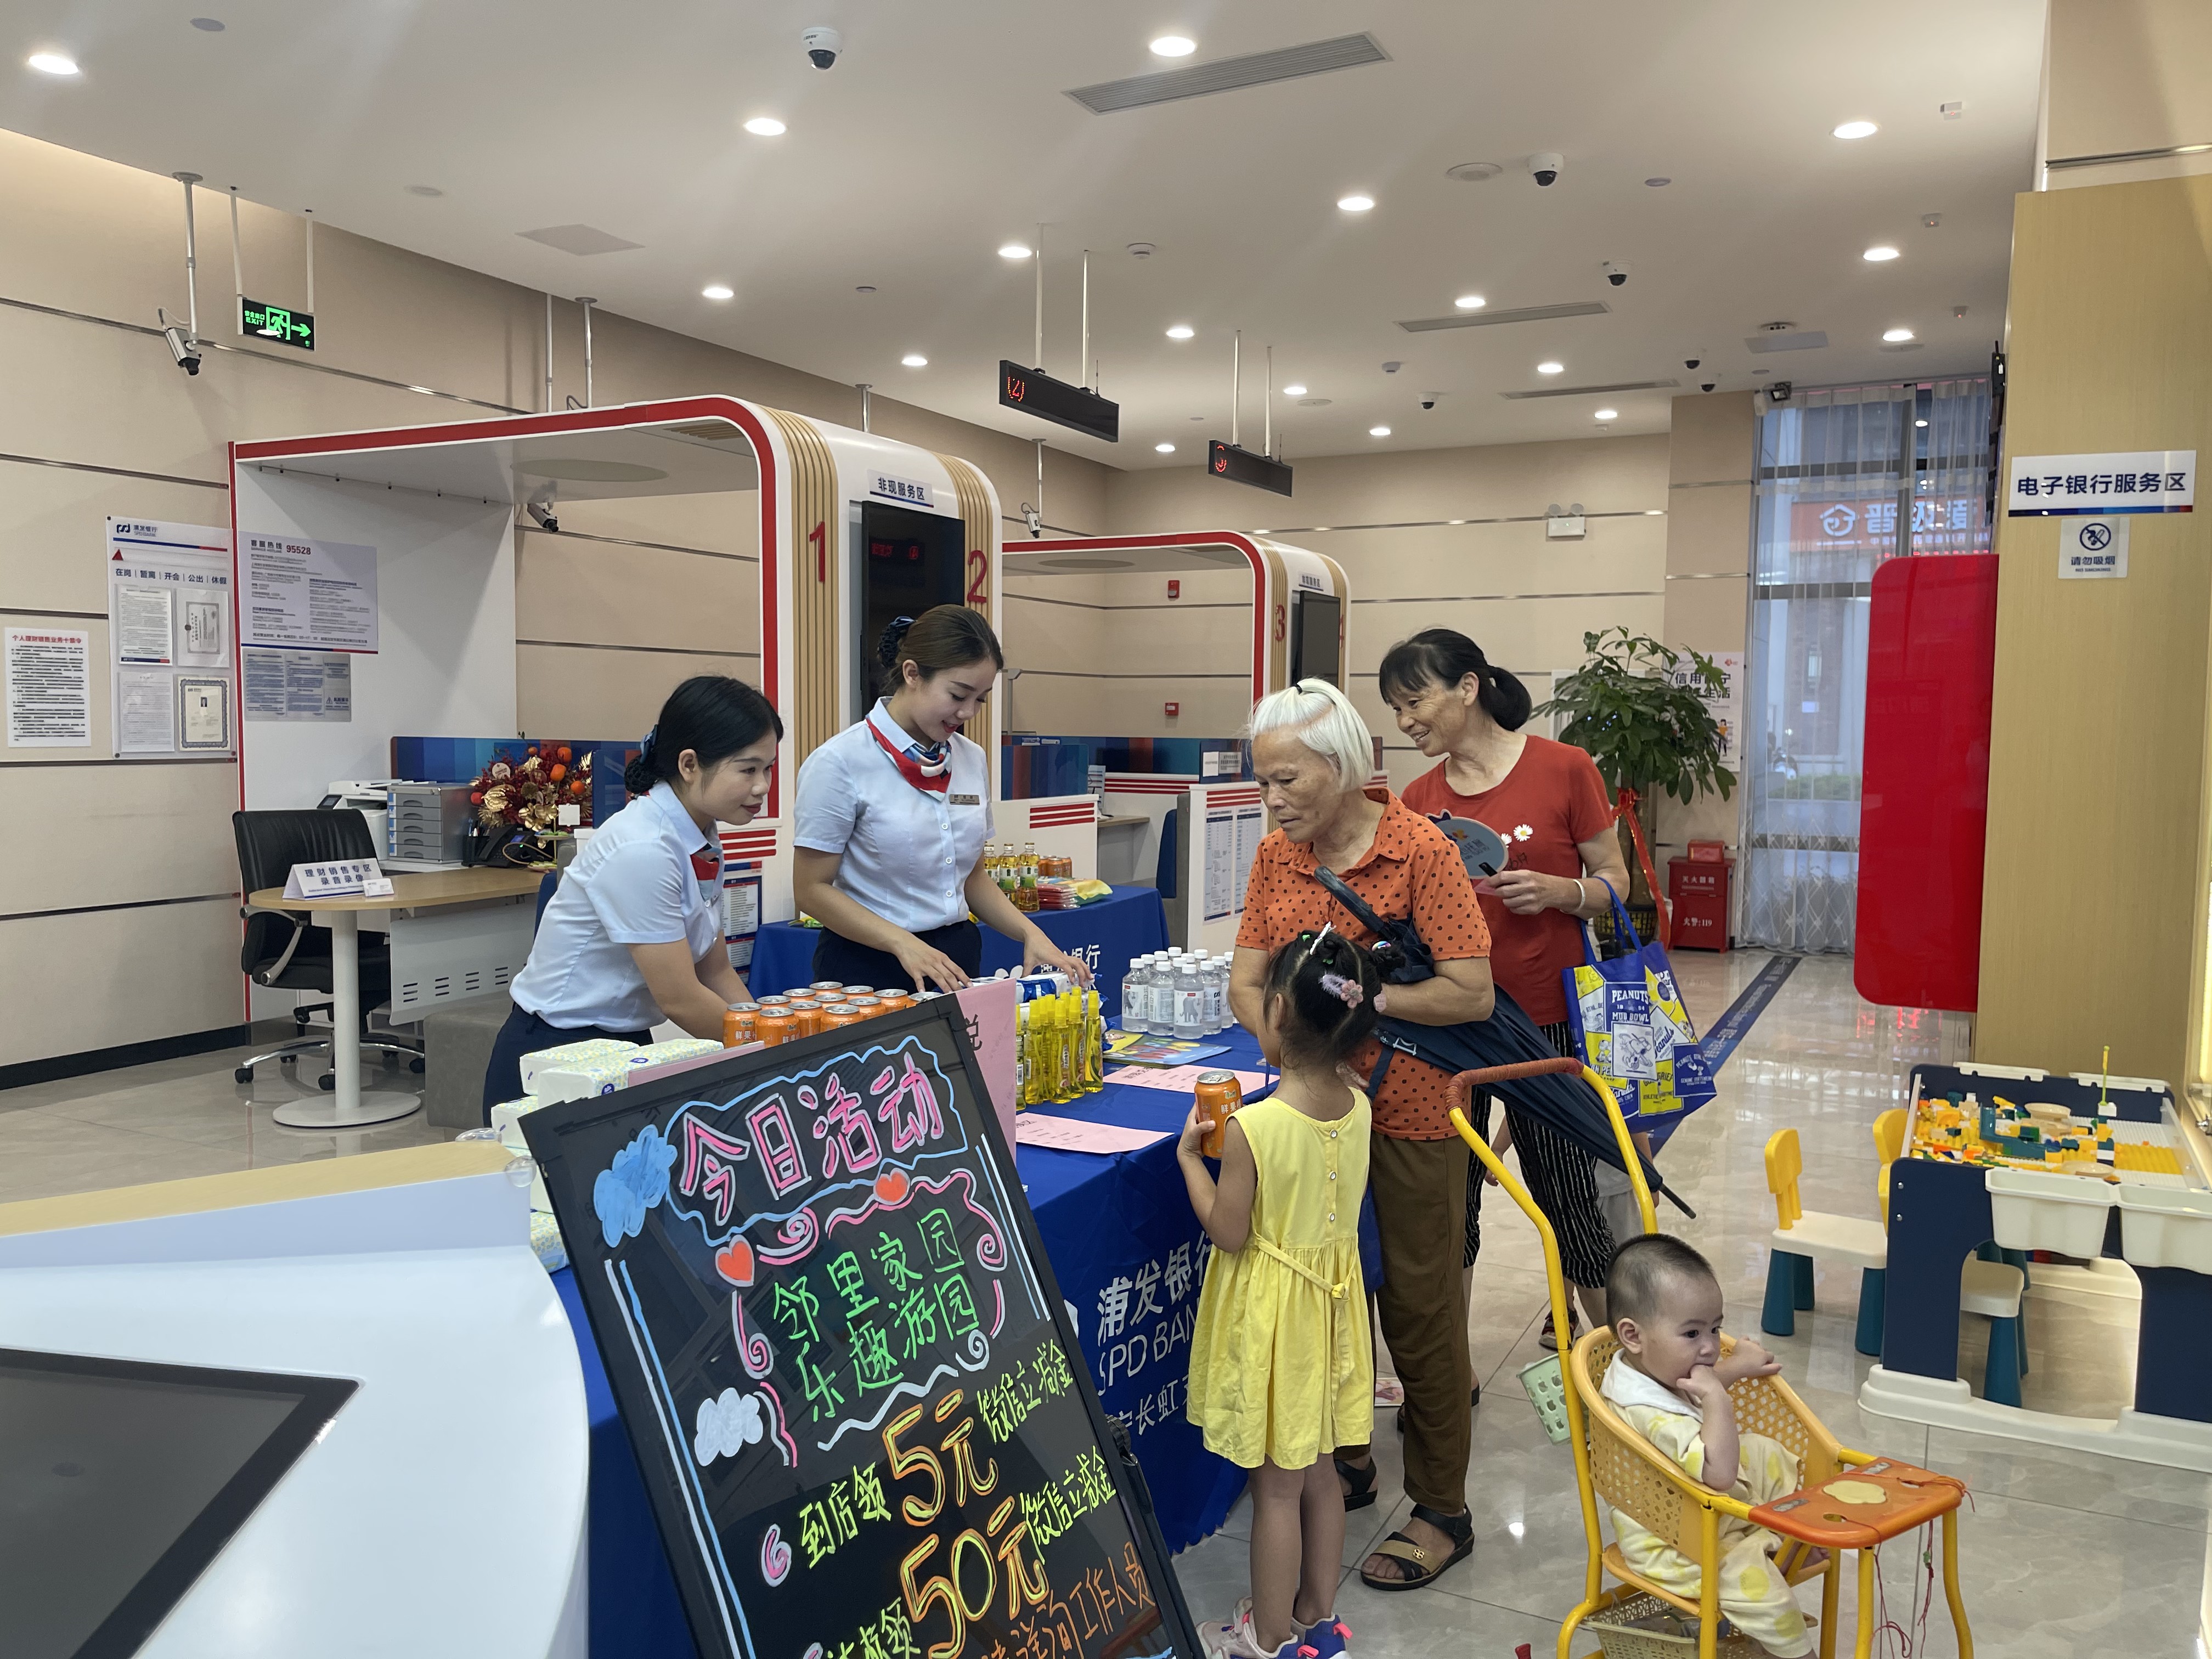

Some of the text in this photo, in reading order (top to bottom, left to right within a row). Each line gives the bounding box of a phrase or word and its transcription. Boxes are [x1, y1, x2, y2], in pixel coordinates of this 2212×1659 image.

[246, 317, 264, 325] EXIT
[878, 477, 925, 500] 非现服务区
[2017, 472, 2186, 495] 电子银行服务区
[286, 544, 311, 555] 95528
[809, 521, 825, 583] 1
[2071, 555, 2115, 566] 请勿吸烟
[116, 568, 131, 577] 在岗
[165, 572, 180, 581] 开会
[188, 574, 204, 583] 公出
[212, 576, 227, 584] 休假
[967, 550, 987, 603] 2
[1274, 604, 1285, 642] 3
[305, 864, 371, 877] 理财销售专区
[1682, 876, 1715, 884] 灭火器箱
[1612, 990, 1649, 1005] PEANUTS
[680, 1052, 943, 1226] 今日活动
[774, 1208, 964, 1342] 邻里家园
[797, 1273, 979, 1422] 乐趣游园
[1098, 1297, 1200, 1396] SPD BAN
[800, 1339, 1073, 1569] 到店领 5元 微信立减金
[1020, 1446, 1116, 1565] 微信立减金
